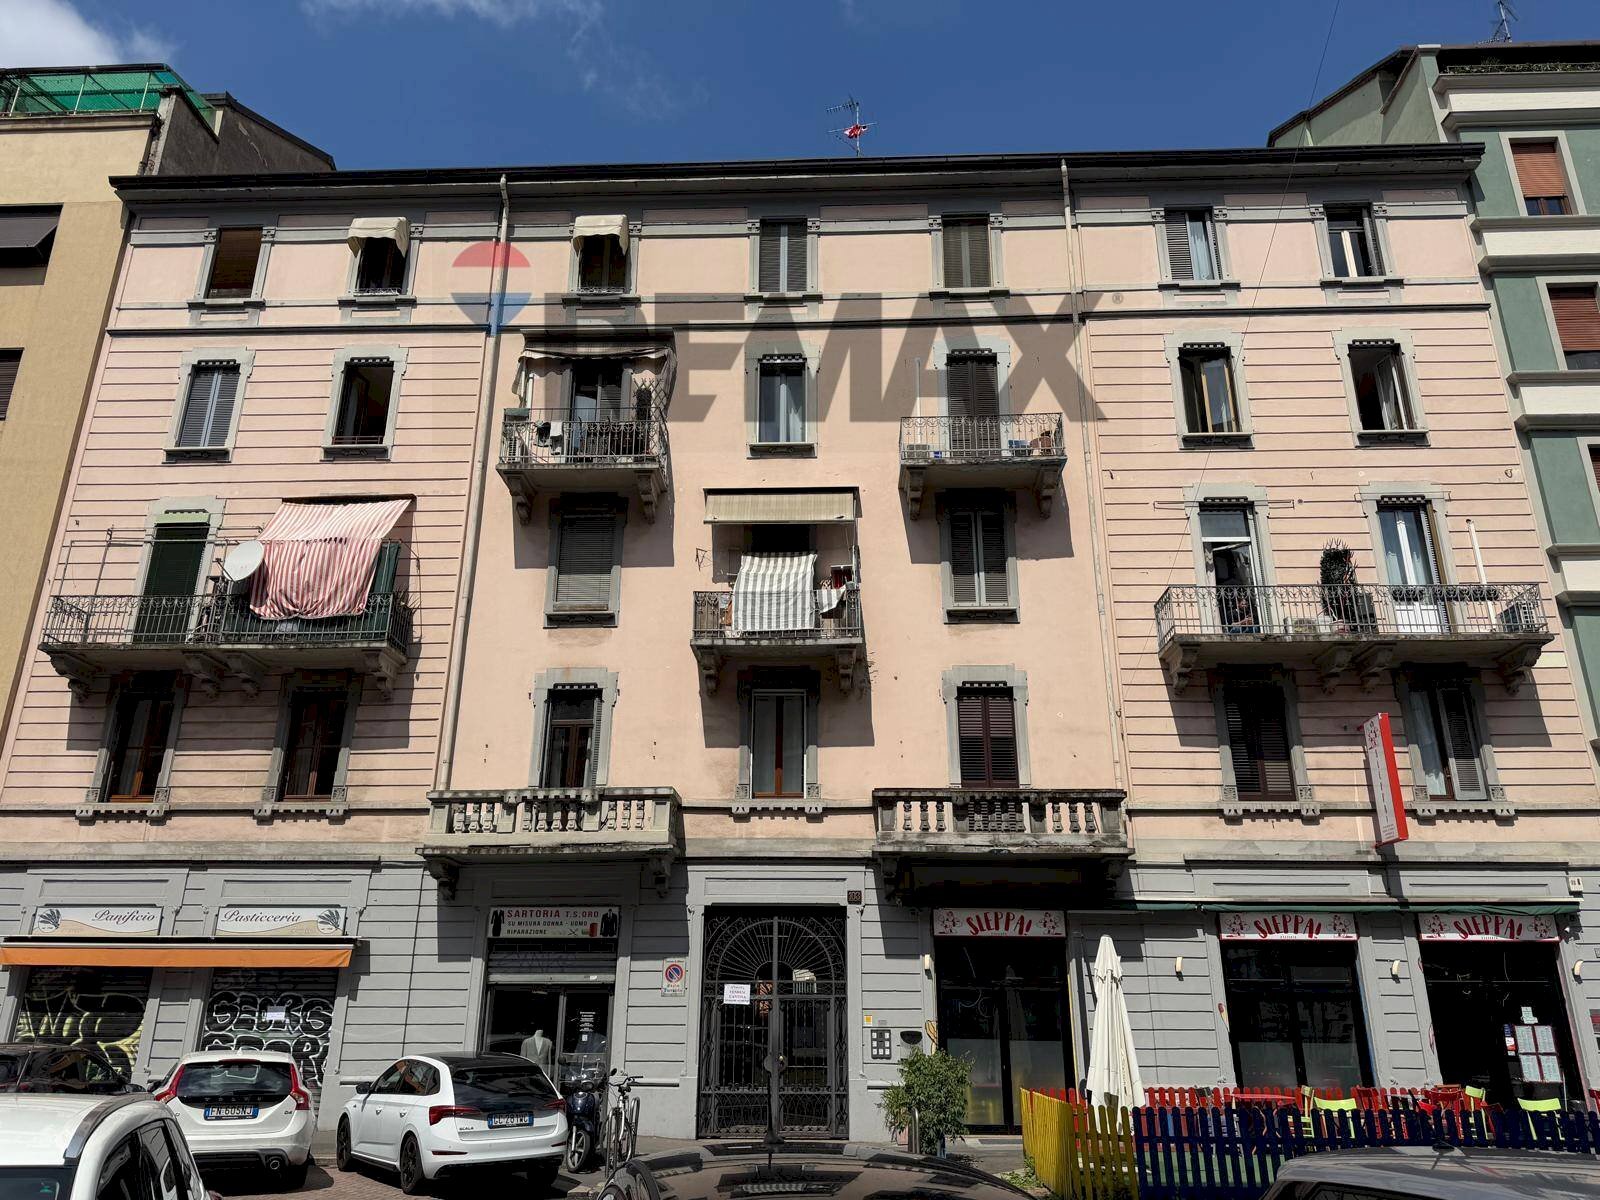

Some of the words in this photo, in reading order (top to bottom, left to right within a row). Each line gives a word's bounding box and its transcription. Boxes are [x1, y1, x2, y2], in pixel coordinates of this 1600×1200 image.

[92, 909, 156, 925] Panificio
[221, 909, 301, 923] Pasticceria
[507, 909, 560, 918] SARTORIA
[966, 911, 1033, 936] SLEPPA!
[1254, 914, 1322, 939] SLEPPA!
[1453, 914, 1523, 939] SLEPPA!
